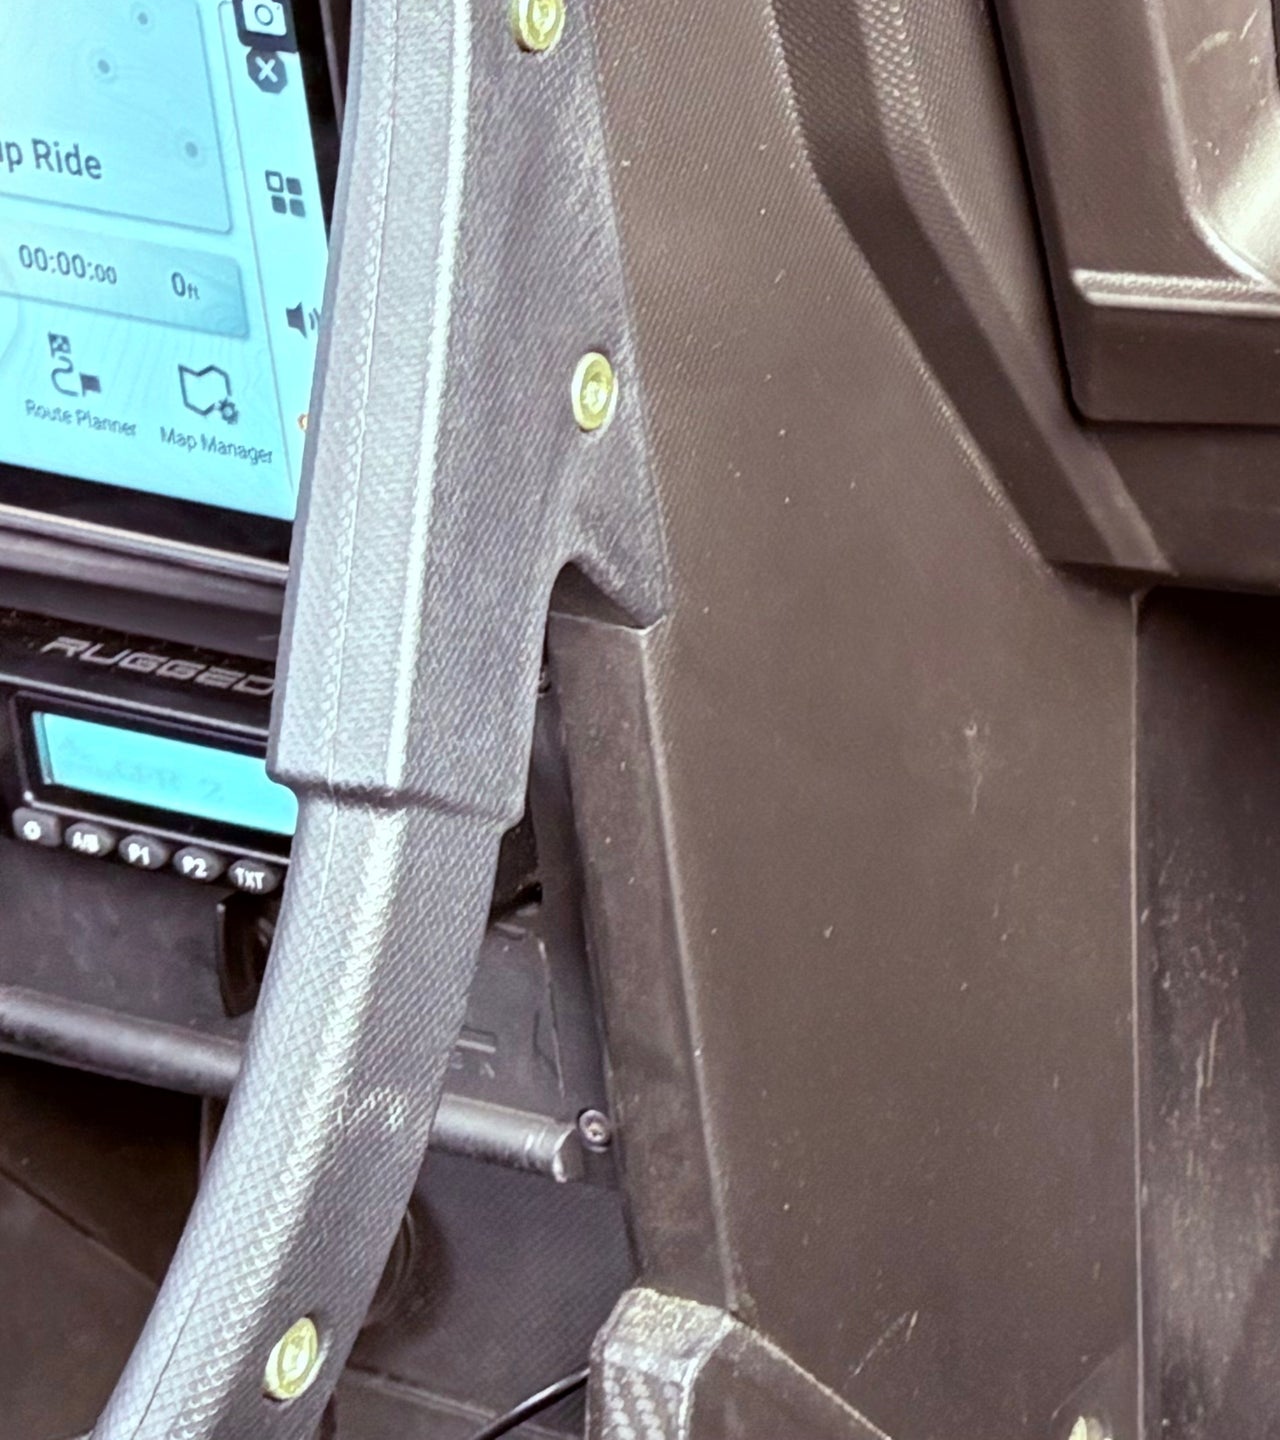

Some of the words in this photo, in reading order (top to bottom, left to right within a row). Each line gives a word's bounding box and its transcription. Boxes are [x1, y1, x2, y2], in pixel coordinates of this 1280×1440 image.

[31, 137, 103, 180] Ride
[18, 244, 118, 285] 00:00:00
[24, 398, 72, 425] Route
[75, 408, 137, 437] Planner
[159, 426, 198, 453] Map
[200, 433, 273, 466] Manager
[40, 635, 275, 696] RUGGED
[127, 842, 150, 866] P1
[181, 855, 208, 879] P2
[234, 866, 265, 891] TXT
